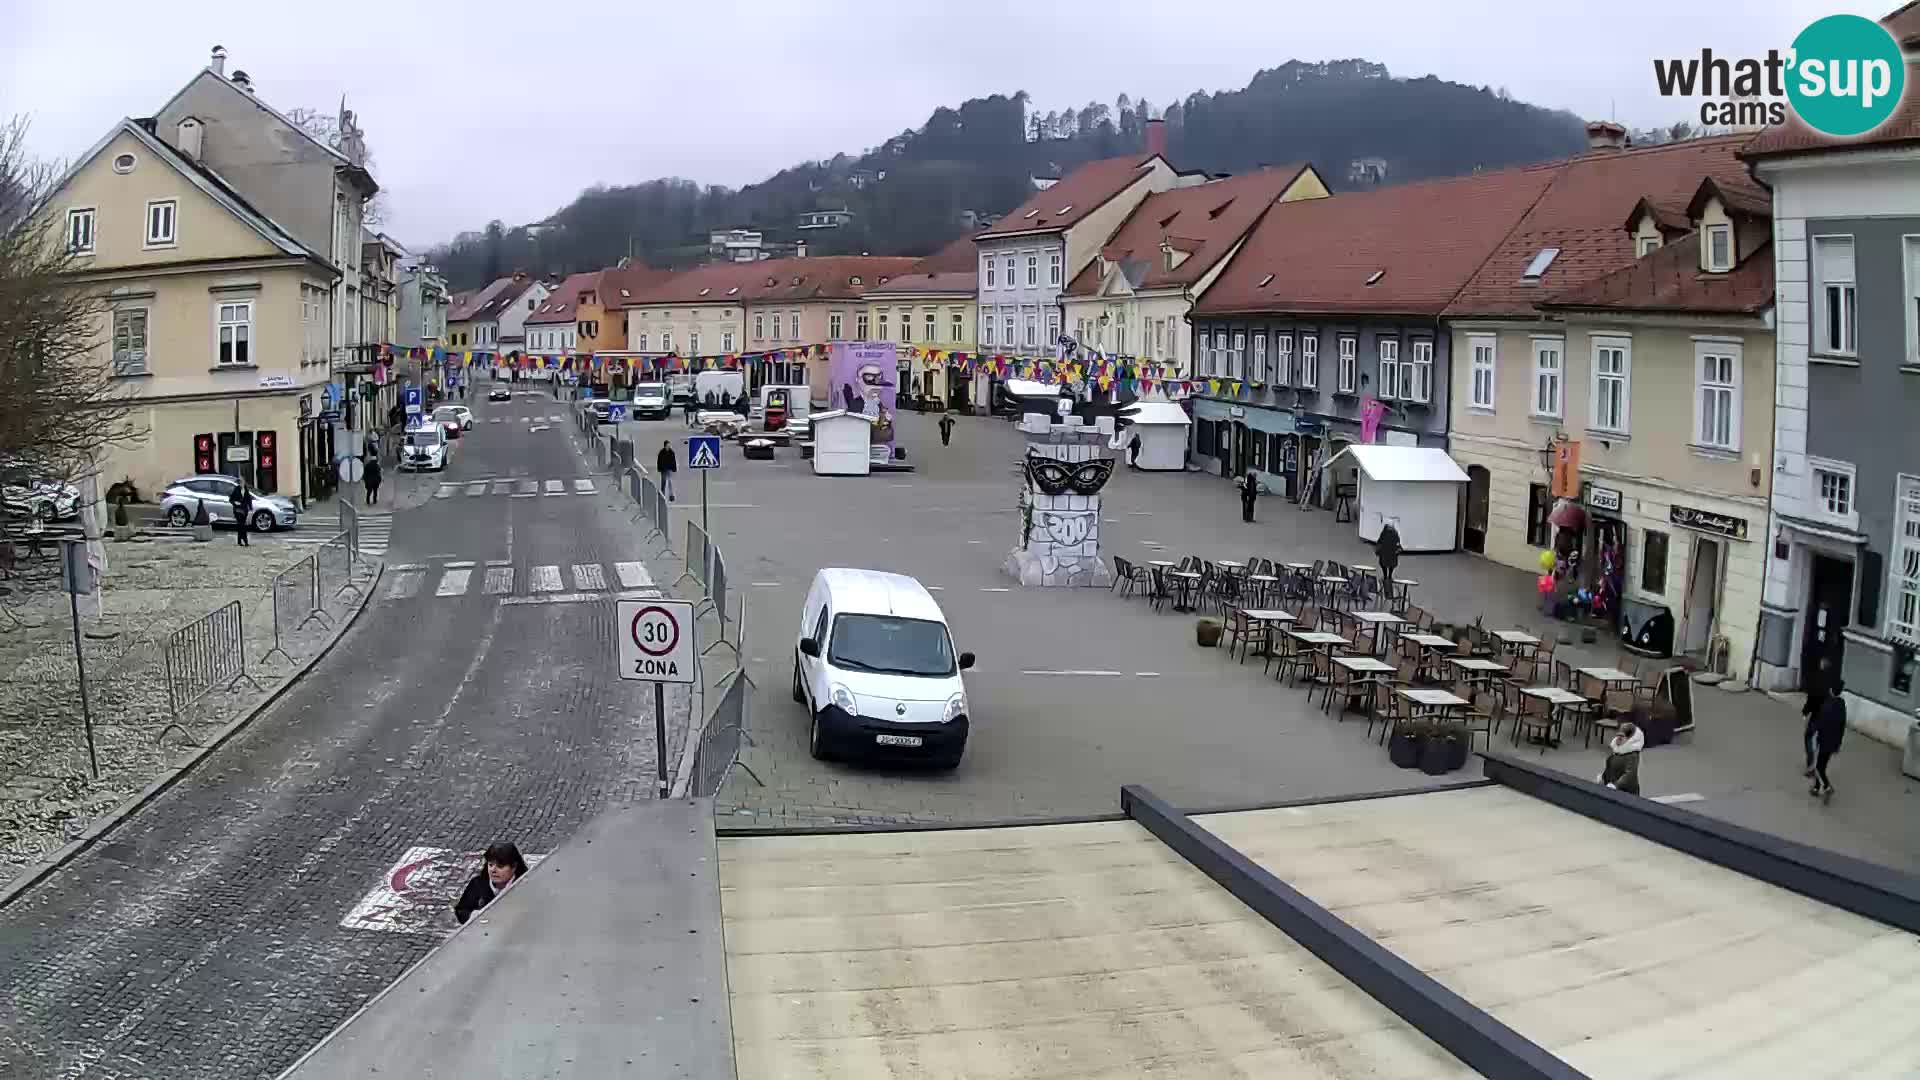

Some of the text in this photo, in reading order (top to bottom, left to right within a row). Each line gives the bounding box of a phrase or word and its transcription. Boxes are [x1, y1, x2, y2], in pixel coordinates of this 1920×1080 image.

[409, 392, 417, 402] P
[1048, 515, 1086, 544] 200
[643, 622, 668, 643] 30
[634, 659, 679, 677] ZONA
